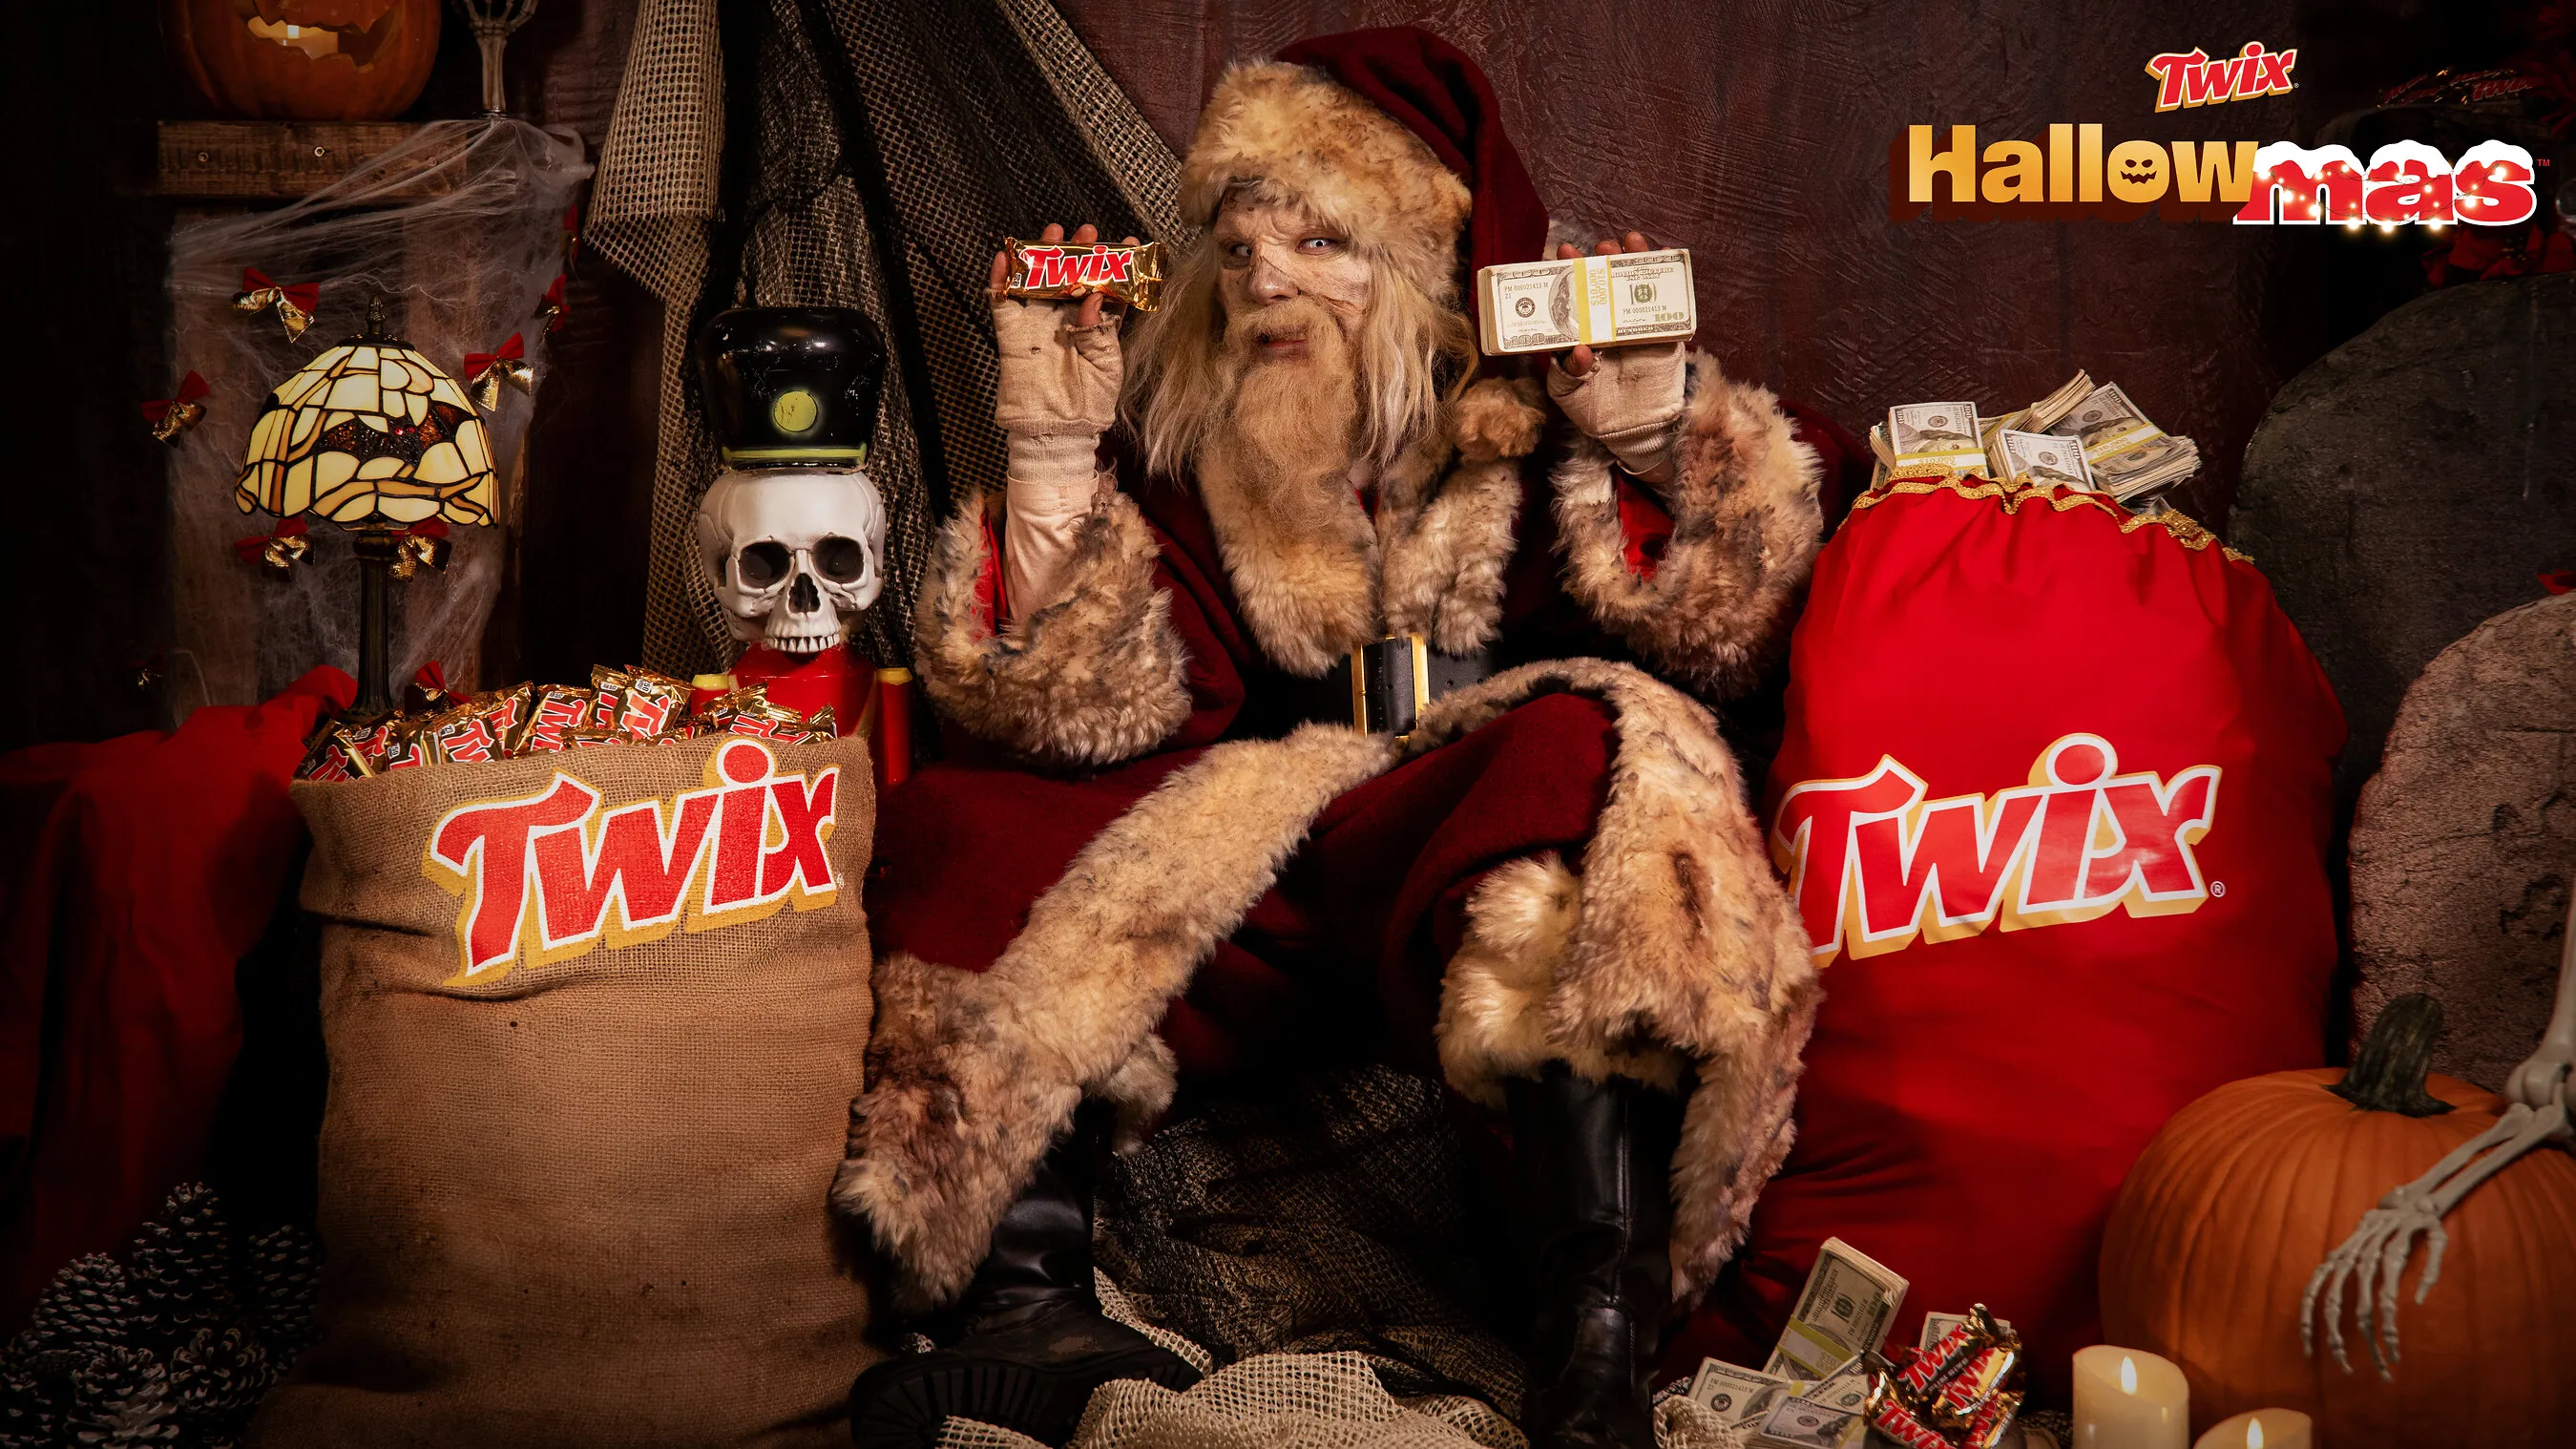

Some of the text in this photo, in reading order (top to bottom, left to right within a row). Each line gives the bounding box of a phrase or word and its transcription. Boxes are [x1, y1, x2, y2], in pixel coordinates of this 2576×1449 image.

[1018, 244, 1134, 290] Twix
[426, 738, 840, 983] Twix
[1771, 733, 2222, 967] Twix
[1897, 1323, 1969, 1394] Twix
